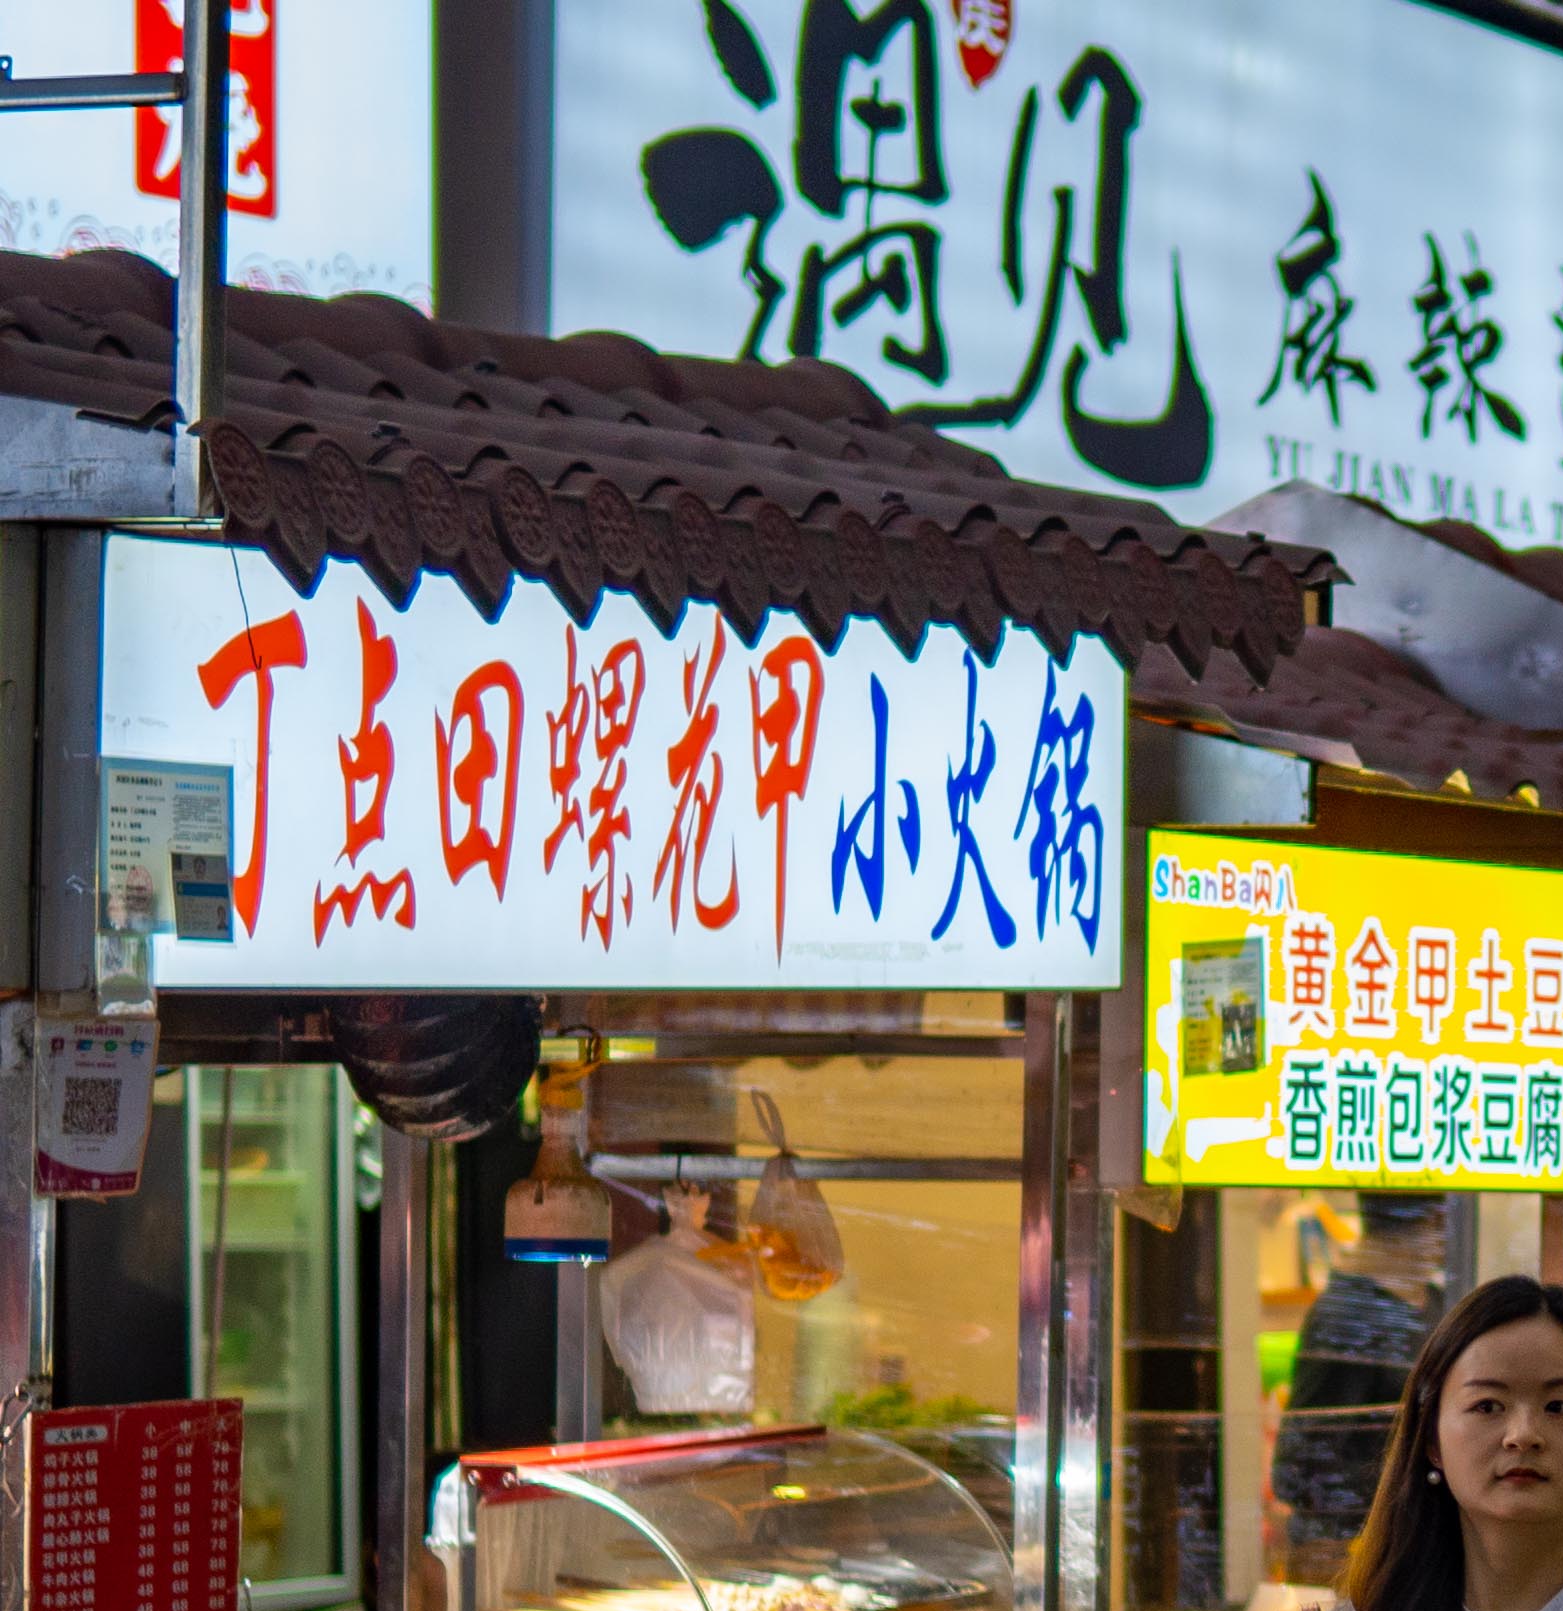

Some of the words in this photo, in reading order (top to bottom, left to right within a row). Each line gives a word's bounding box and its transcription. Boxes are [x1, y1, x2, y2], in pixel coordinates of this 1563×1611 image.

[1326, 448, 1416, 504] JIAN
[1430, 472, 1480, 522] MA
[1493, 488, 1537, 536] LA
[1285, 1060, 1563, 1168] 香煎包浆豆腐
